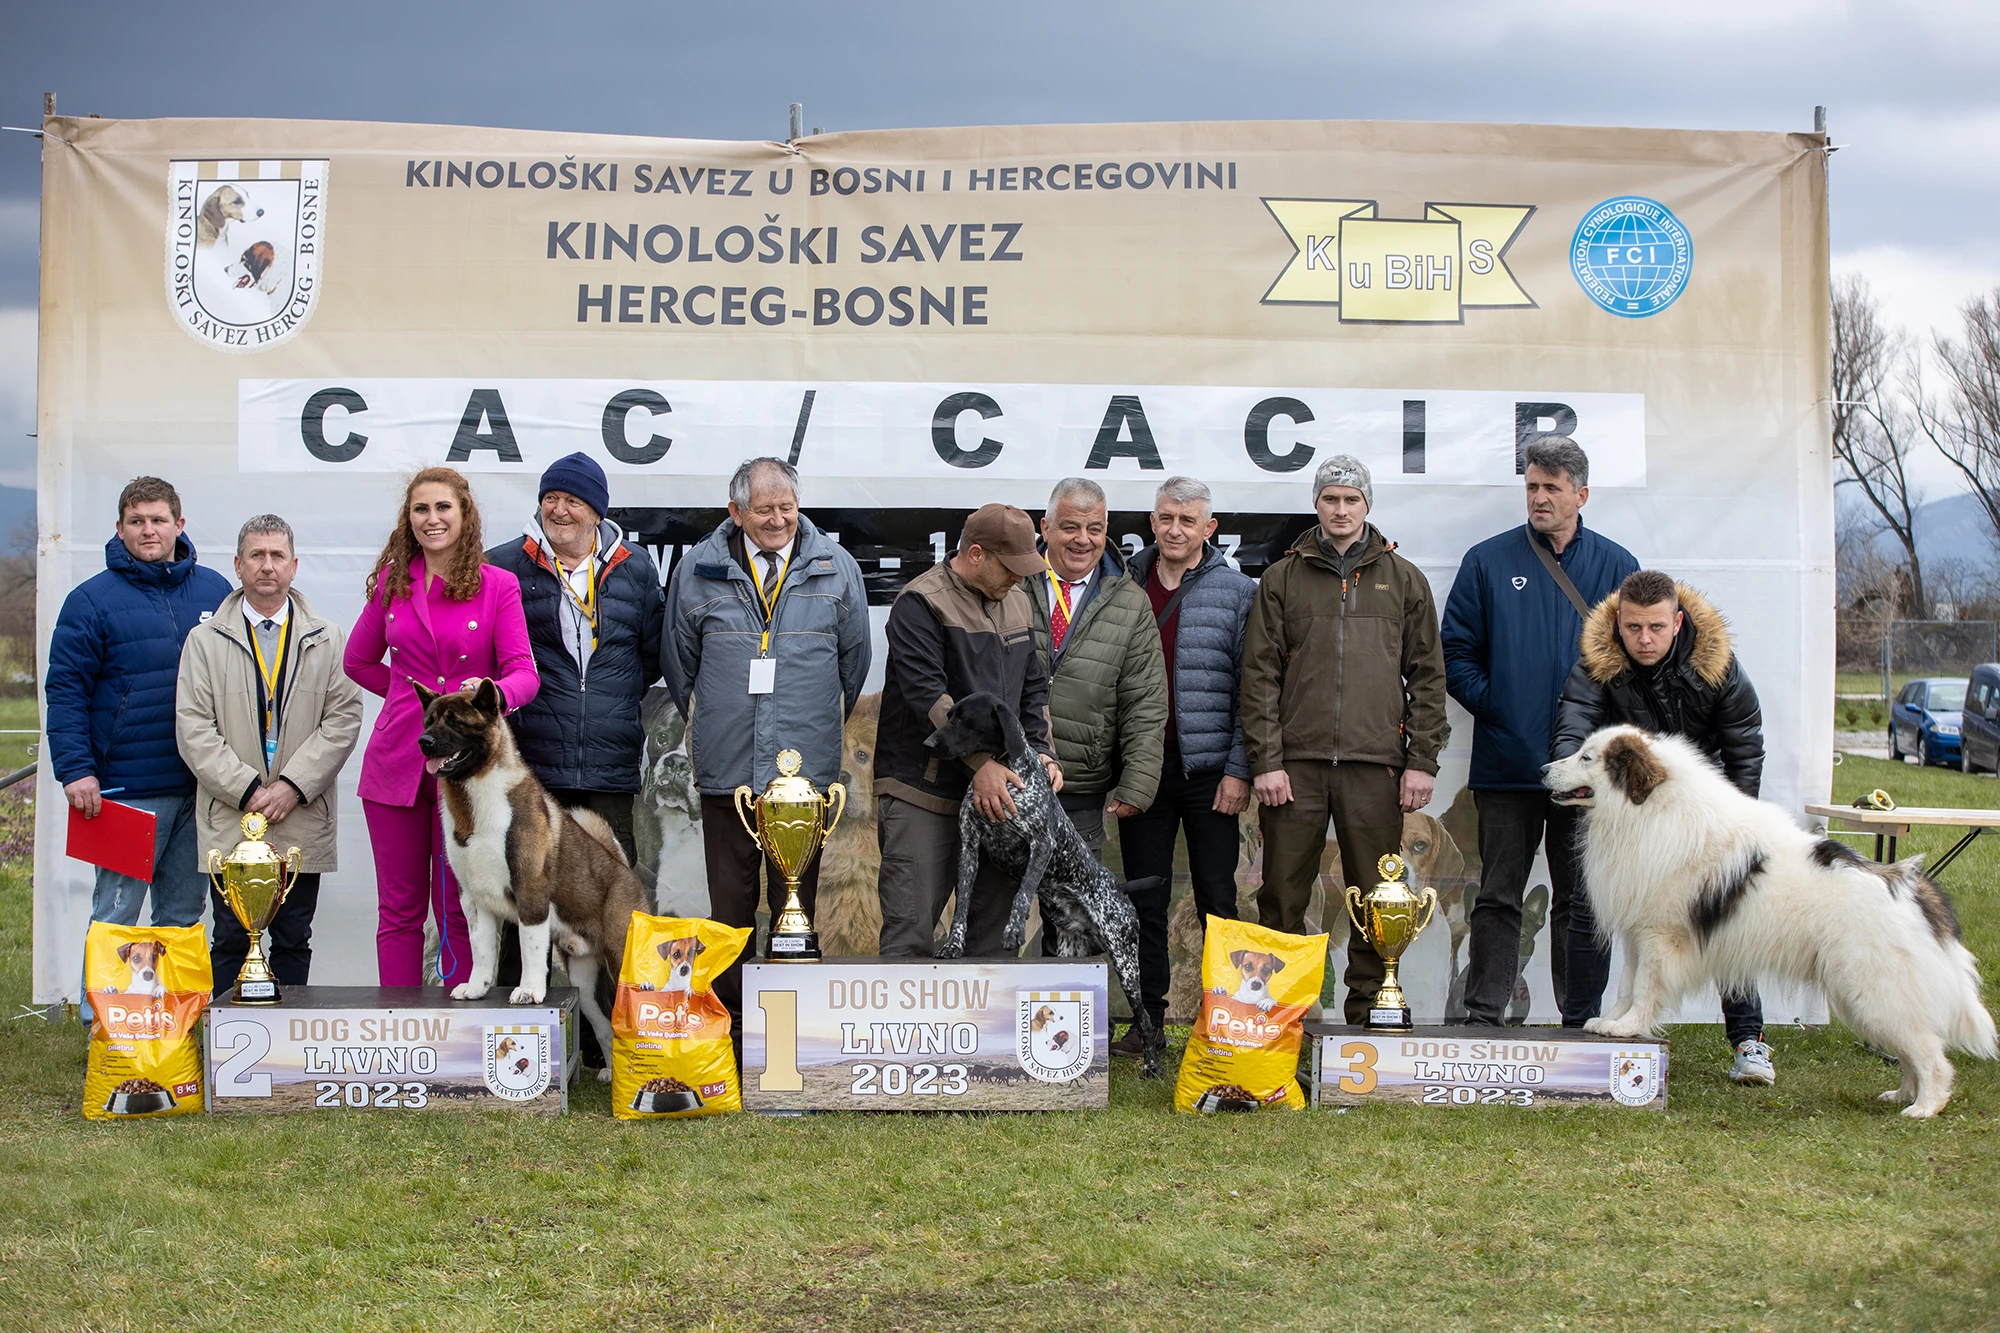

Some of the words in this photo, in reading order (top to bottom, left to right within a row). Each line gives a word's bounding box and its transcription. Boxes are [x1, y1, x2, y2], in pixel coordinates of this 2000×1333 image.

[406, 155, 618, 192] KINOLOŠKI
[634, 164, 753, 196] SAVEZ
[768, 170, 793, 195] U
[810, 167, 925, 196] BOSNI
[943, 169, 951, 191] I
[969, 161, 1238, 191] HERCEGOVINI
[1583, 202, 1660, 237] CYNOLOGIQUE
[547, 213, 837, 264] KINOLOŠKI
[861, 222, 1024, 262] SAVEZ
[1607, 246, 1655, 264] FCI
[175, 179, 194, 308] KINOLOŠKI
[189, 311, 248, 345] SAVEZ
[255, 277, 313, 343] HERCEG
[300, 179, 319, 255] BOSNE
[1577, 239, 1616, 306] FEDERATION
[1650, 216, 1687, 306] INTERNATIONALE
[577, 284, 989, 327] HERCEG-BOSNE
[301, 387, 672, 465] CAC
[828, 979, 889, 1010] DOG
[899, 979, 990, 1010] SHOW
[107, 1001, 176, 1032] Petis
[289, 1018, 349, 1042] DOG
[359, 1018, 450, 1042] SHOW
[1208, 1007, 1282, 1040] Petis
[107, 1044, 135, 1052] piletina
[636, 1042, 662, 1050] piletina
[758, 990, 804, 1092] 1
[841, 1022, 979, 1055] LIVNO
[1028, 1062, 1058, 1078] SAVEZ
[1062, 1046, 1090, 1078] HERCEG
[1082, 1000, 1090, 1036] BOSNE
[1400, 1041, 1460, 1058] DOG
[1470, 1042, 1560, 1062] SHOW
[215, 1020, 273, 1097] 2
[304, 1047, 437, 1075] LIVNO
[1338, 1041, 1379, 1094] 3
[1414, 1061, 1545, 1085] LIVNO
[177, 1086, 183, 1094] 8
[186, 1084, 197, 1093] kg
[315, 1081, 429, 1109] 2023
[494, 1084, 520, 1098] SAVEZ
[524, 1071, 548, 1097] HERCEG
[713, 1084, 725, 1094] kg
[850, 1063, 968, 1096] 2023
[1422, 1084, 1535, 1108] 2023
